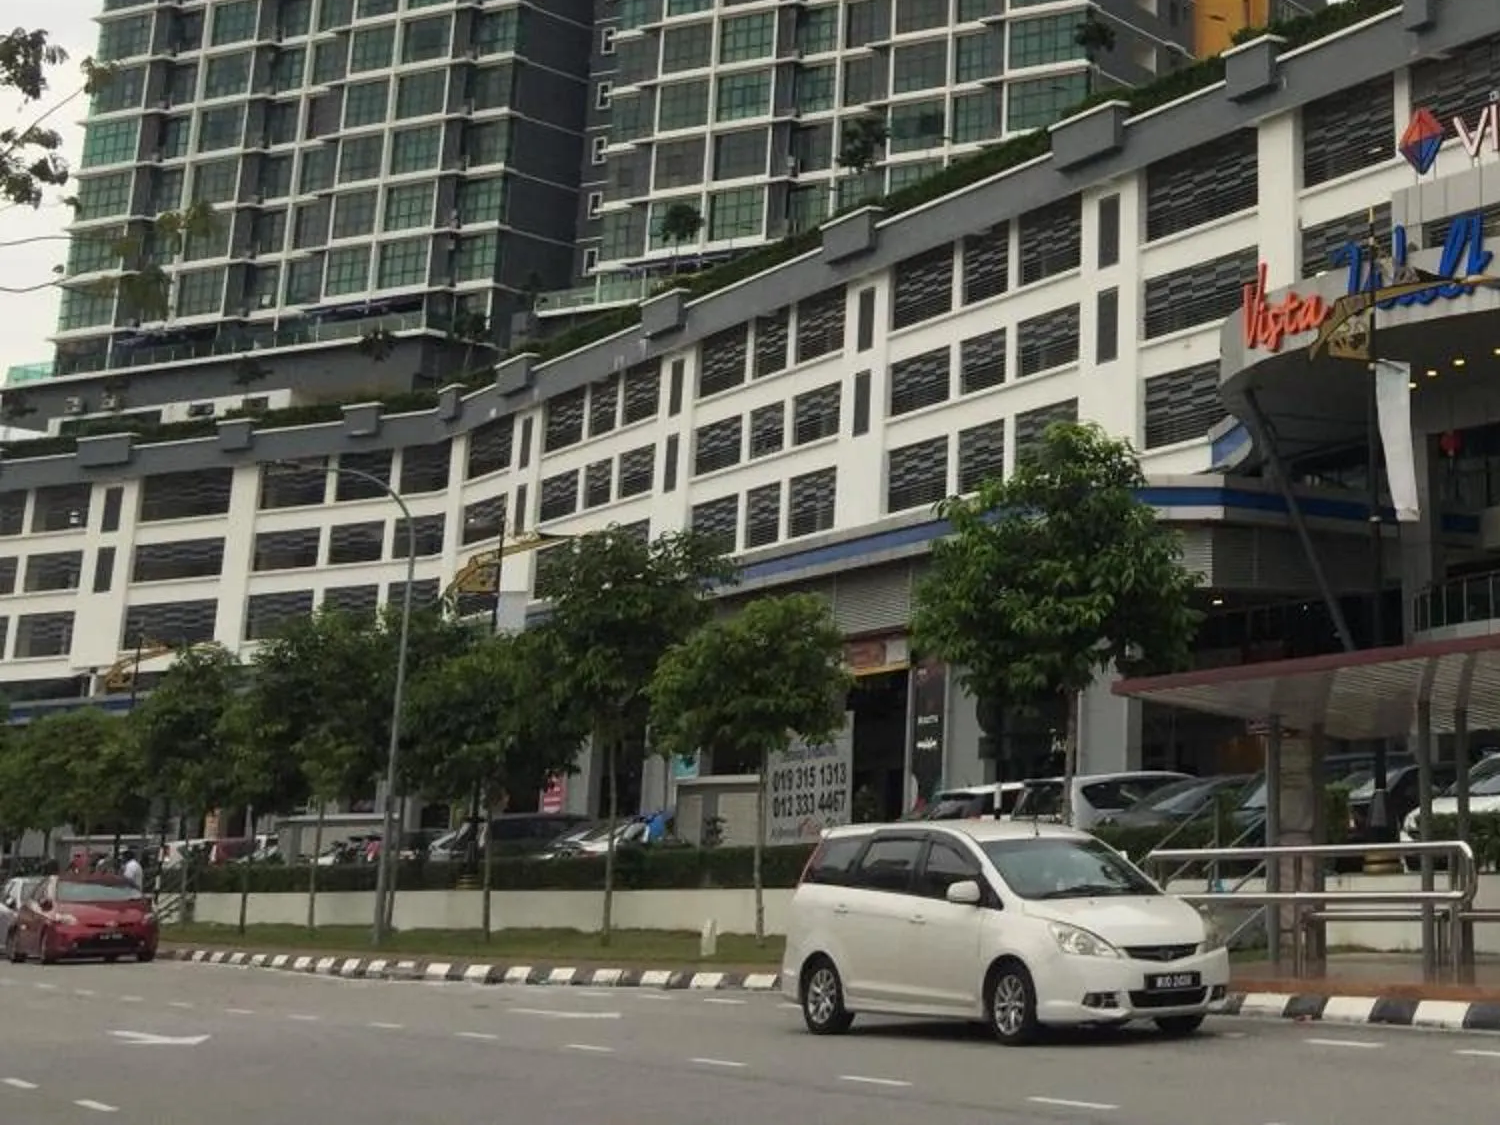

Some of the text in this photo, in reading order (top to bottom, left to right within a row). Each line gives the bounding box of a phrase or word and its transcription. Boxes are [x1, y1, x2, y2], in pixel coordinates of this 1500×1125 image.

[1243, 262, 1332, 352] Vista
[797, 765, 816, 789] 315
[819, 762, 847, 787] 1313
